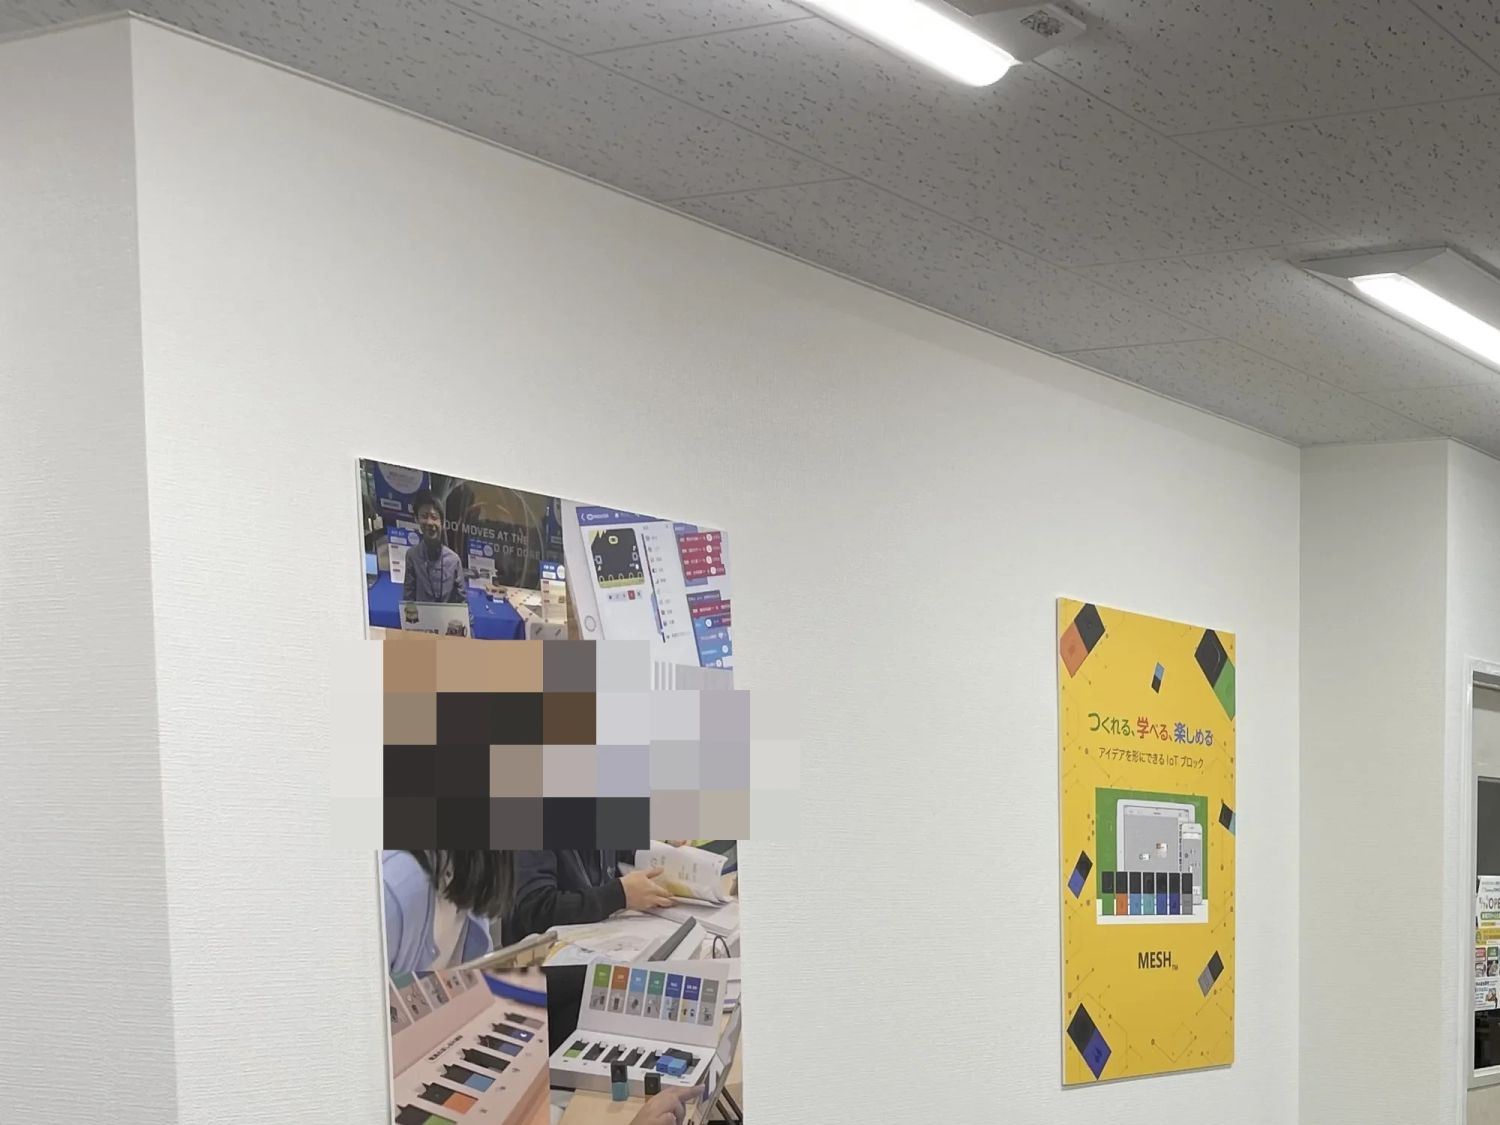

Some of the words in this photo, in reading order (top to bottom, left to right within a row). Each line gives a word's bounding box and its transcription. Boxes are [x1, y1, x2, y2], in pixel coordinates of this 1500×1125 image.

[462, 523, 495, 539] MOVES
[498, 530, 509, 541] AT
[1088, 712, 1213, 746] つくれる、学べる、楽しめる
[1099, 747, 1165, 765] アイデアを形にできる
[1166, 755, 1178, 767] IoT
[1181, 756, 1204, 769] ブロック
[1138, 951, 1171, 969] MESH
